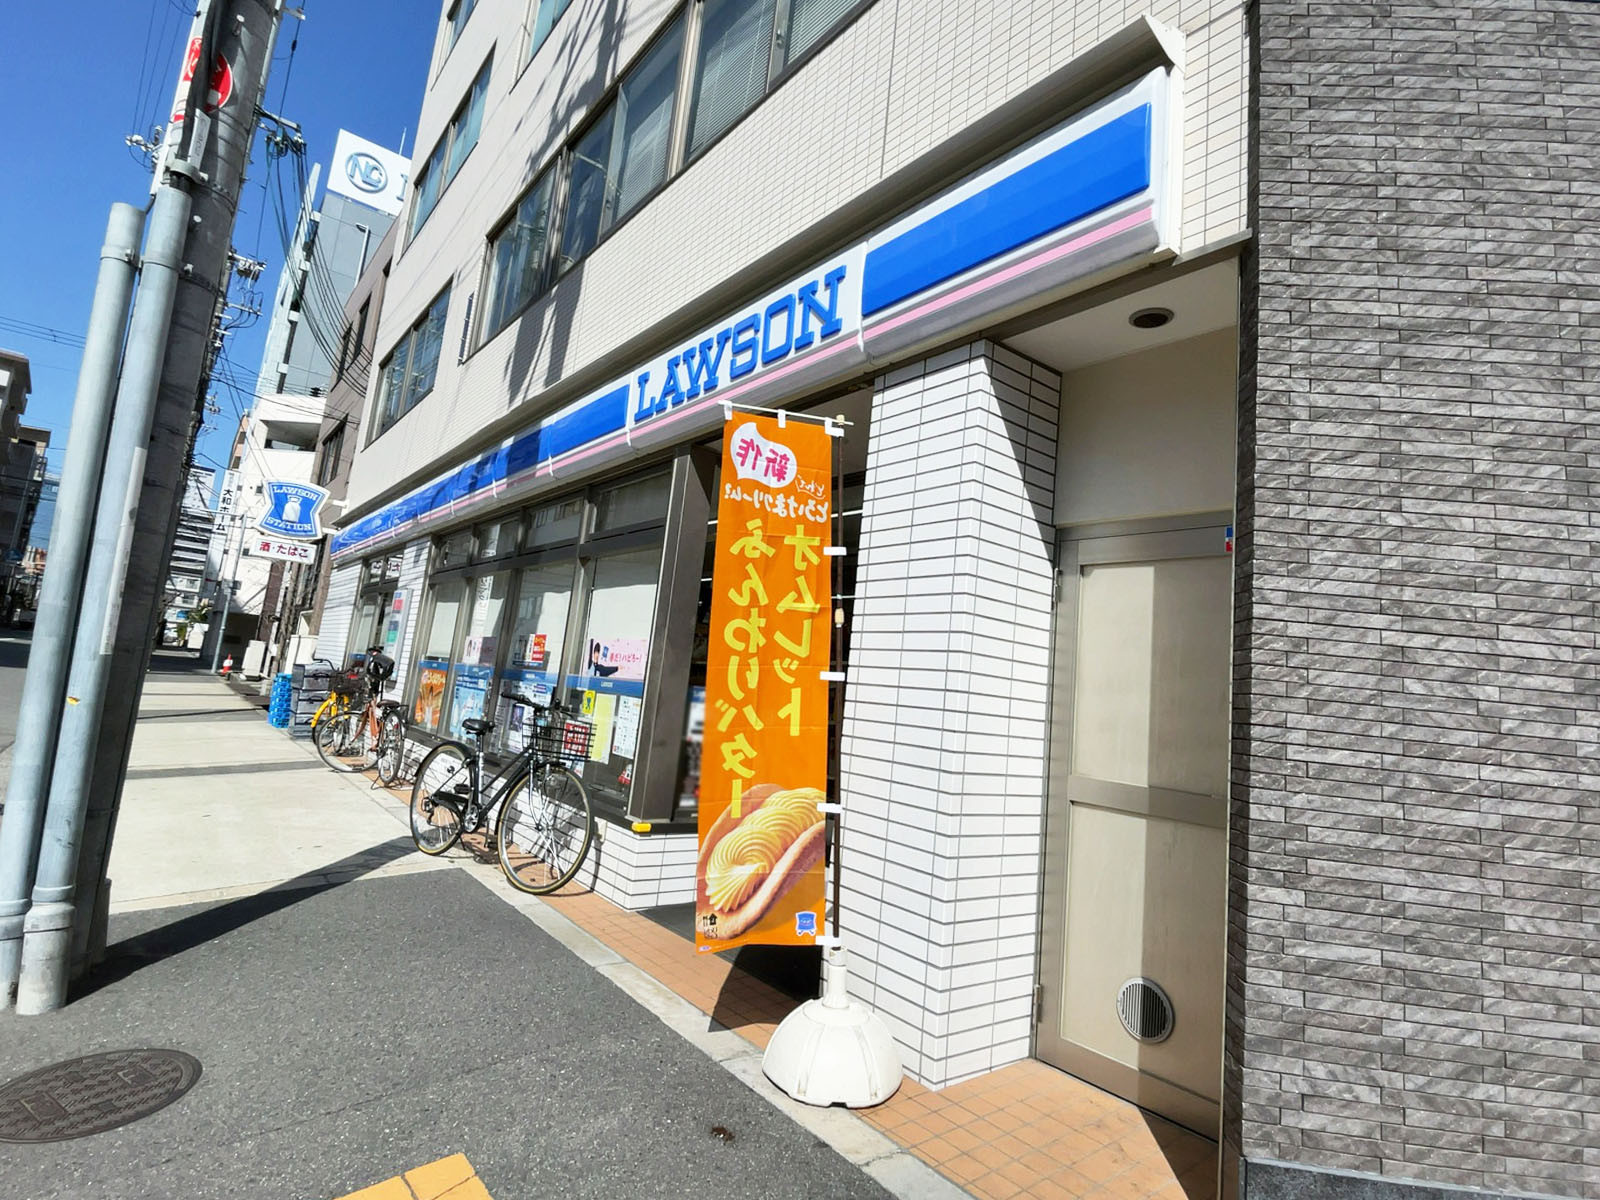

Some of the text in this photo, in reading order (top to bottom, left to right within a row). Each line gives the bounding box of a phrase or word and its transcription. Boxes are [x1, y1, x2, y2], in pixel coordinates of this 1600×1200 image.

[634, 265, 847, 422] LAWSON
[273, 486, 318, 501] LAWSON
[215, 489, 234, 531] 大和ホーム
[266, 516, 312, 531] STATION
